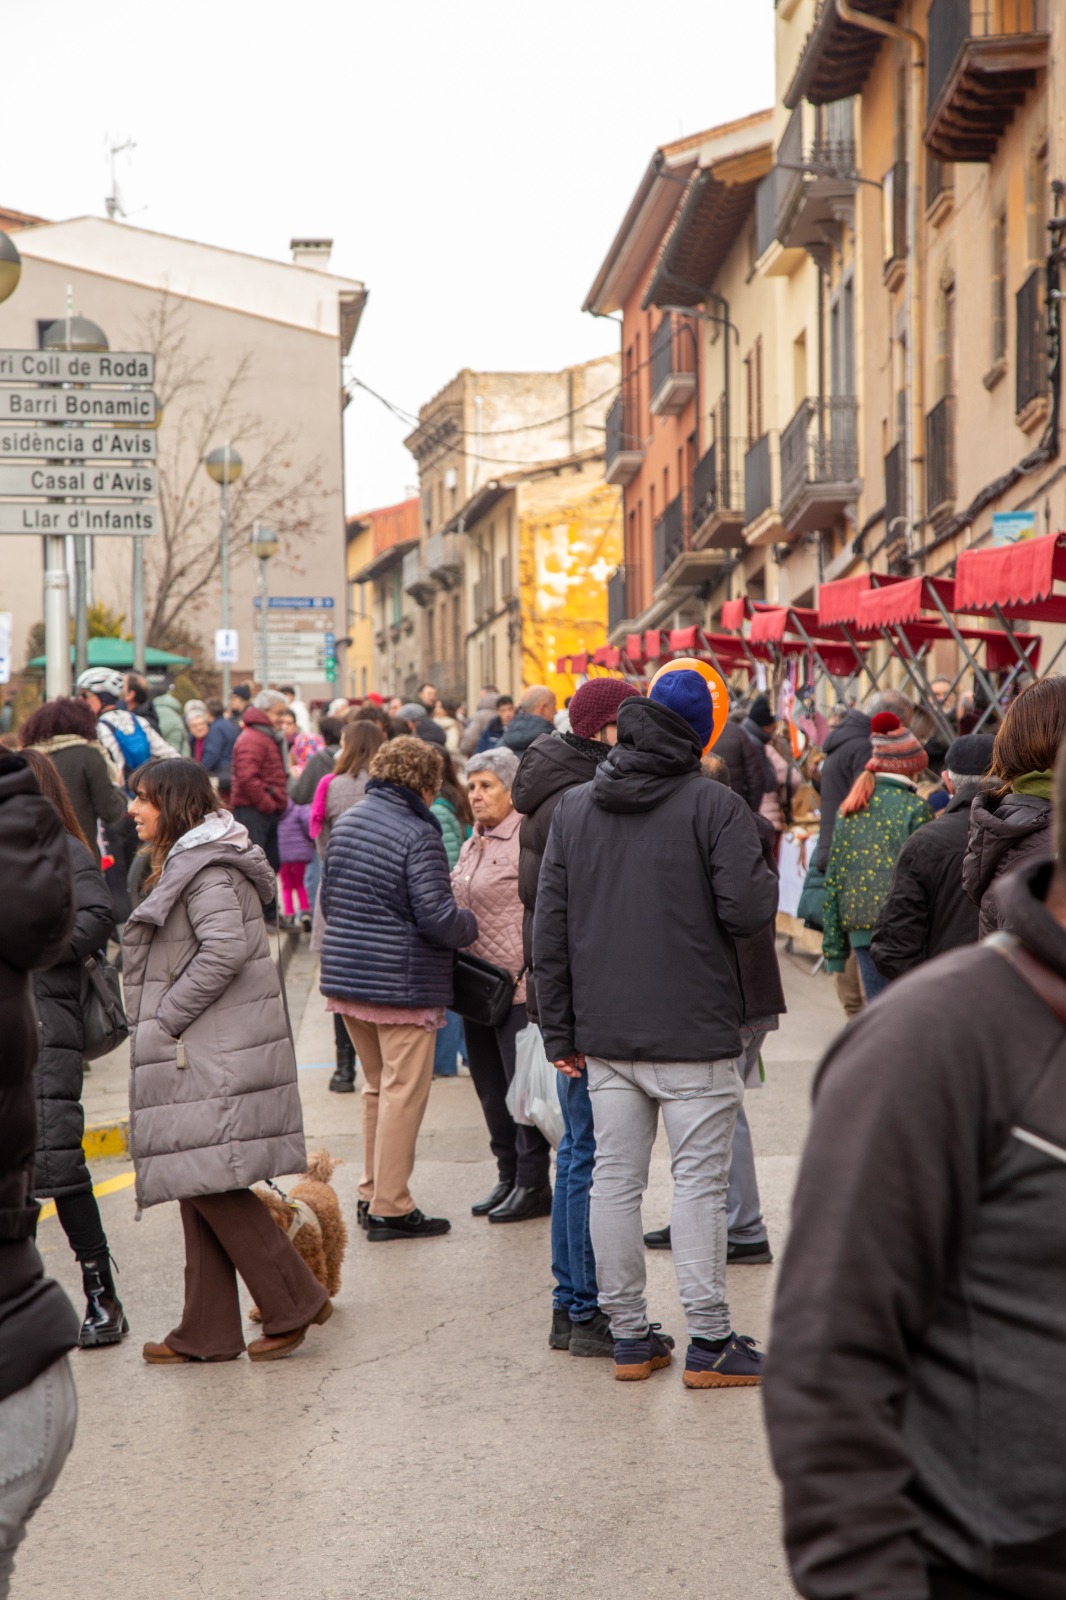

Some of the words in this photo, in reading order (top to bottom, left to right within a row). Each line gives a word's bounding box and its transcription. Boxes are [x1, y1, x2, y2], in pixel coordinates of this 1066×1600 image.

[22, 356, 60, 375] Coll
[68, 357, 91, 376] de
[99, 358, 149, 377] Roda
[9, 394, 57, 413] Barri
[66, 396, 150, 414] Bonamic
[92, 434, 152, 453] d'Avis
[31, 470, 85, 490] Casal
[93, 473, 153, 492] d'Avis
[22, 509, 60, 528] Llar
[67, 510, 153, 528] d'Infants
